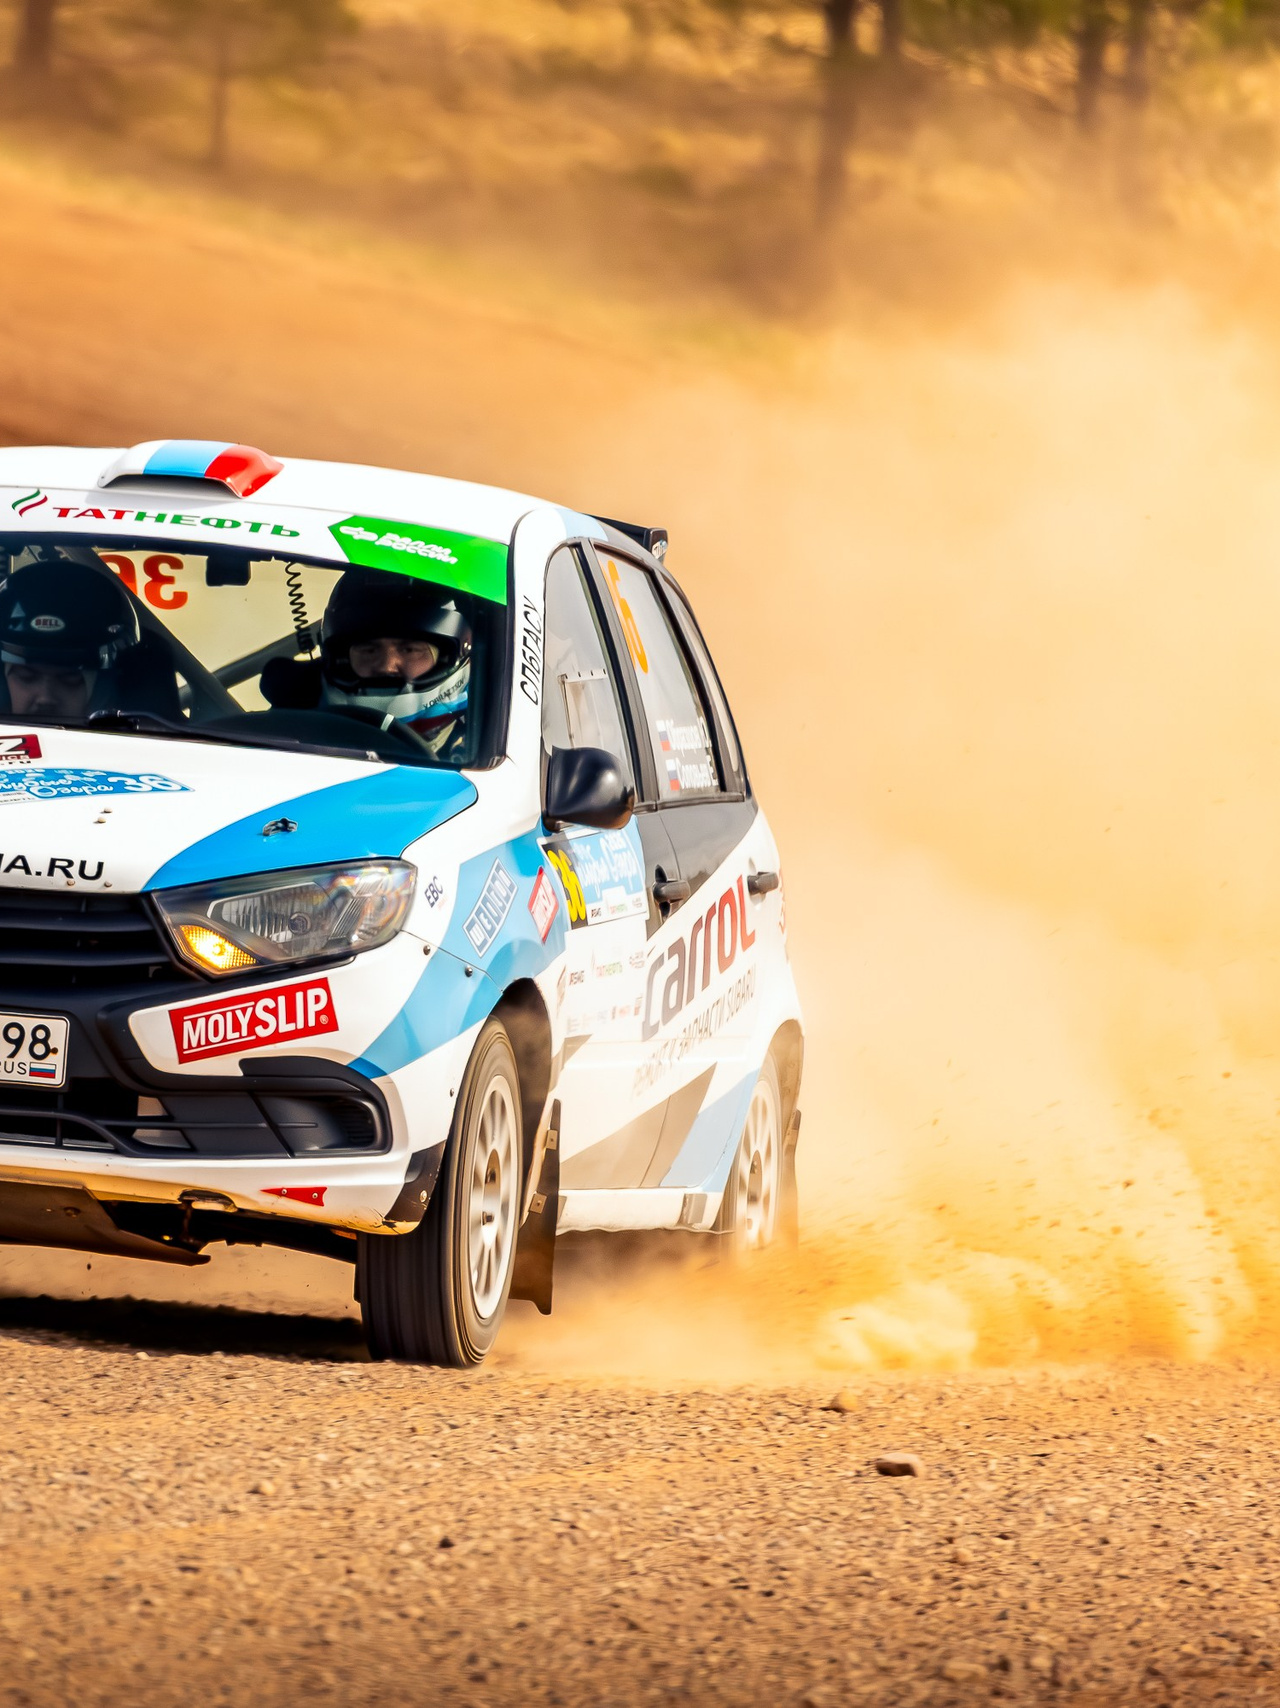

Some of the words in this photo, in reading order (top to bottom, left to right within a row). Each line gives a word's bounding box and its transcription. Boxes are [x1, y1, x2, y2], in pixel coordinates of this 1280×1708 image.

[52, 507, 300, 537] ТАТНЕФТЬ
[34, 618, 61, 627] BELL
[520, 596, 543, 705] СПБГАСУ
[107, 774, 183, 793] 36
[423, 875, 444, 909] EBC
[182, 987, 328, 1050] MOLYSLIP
